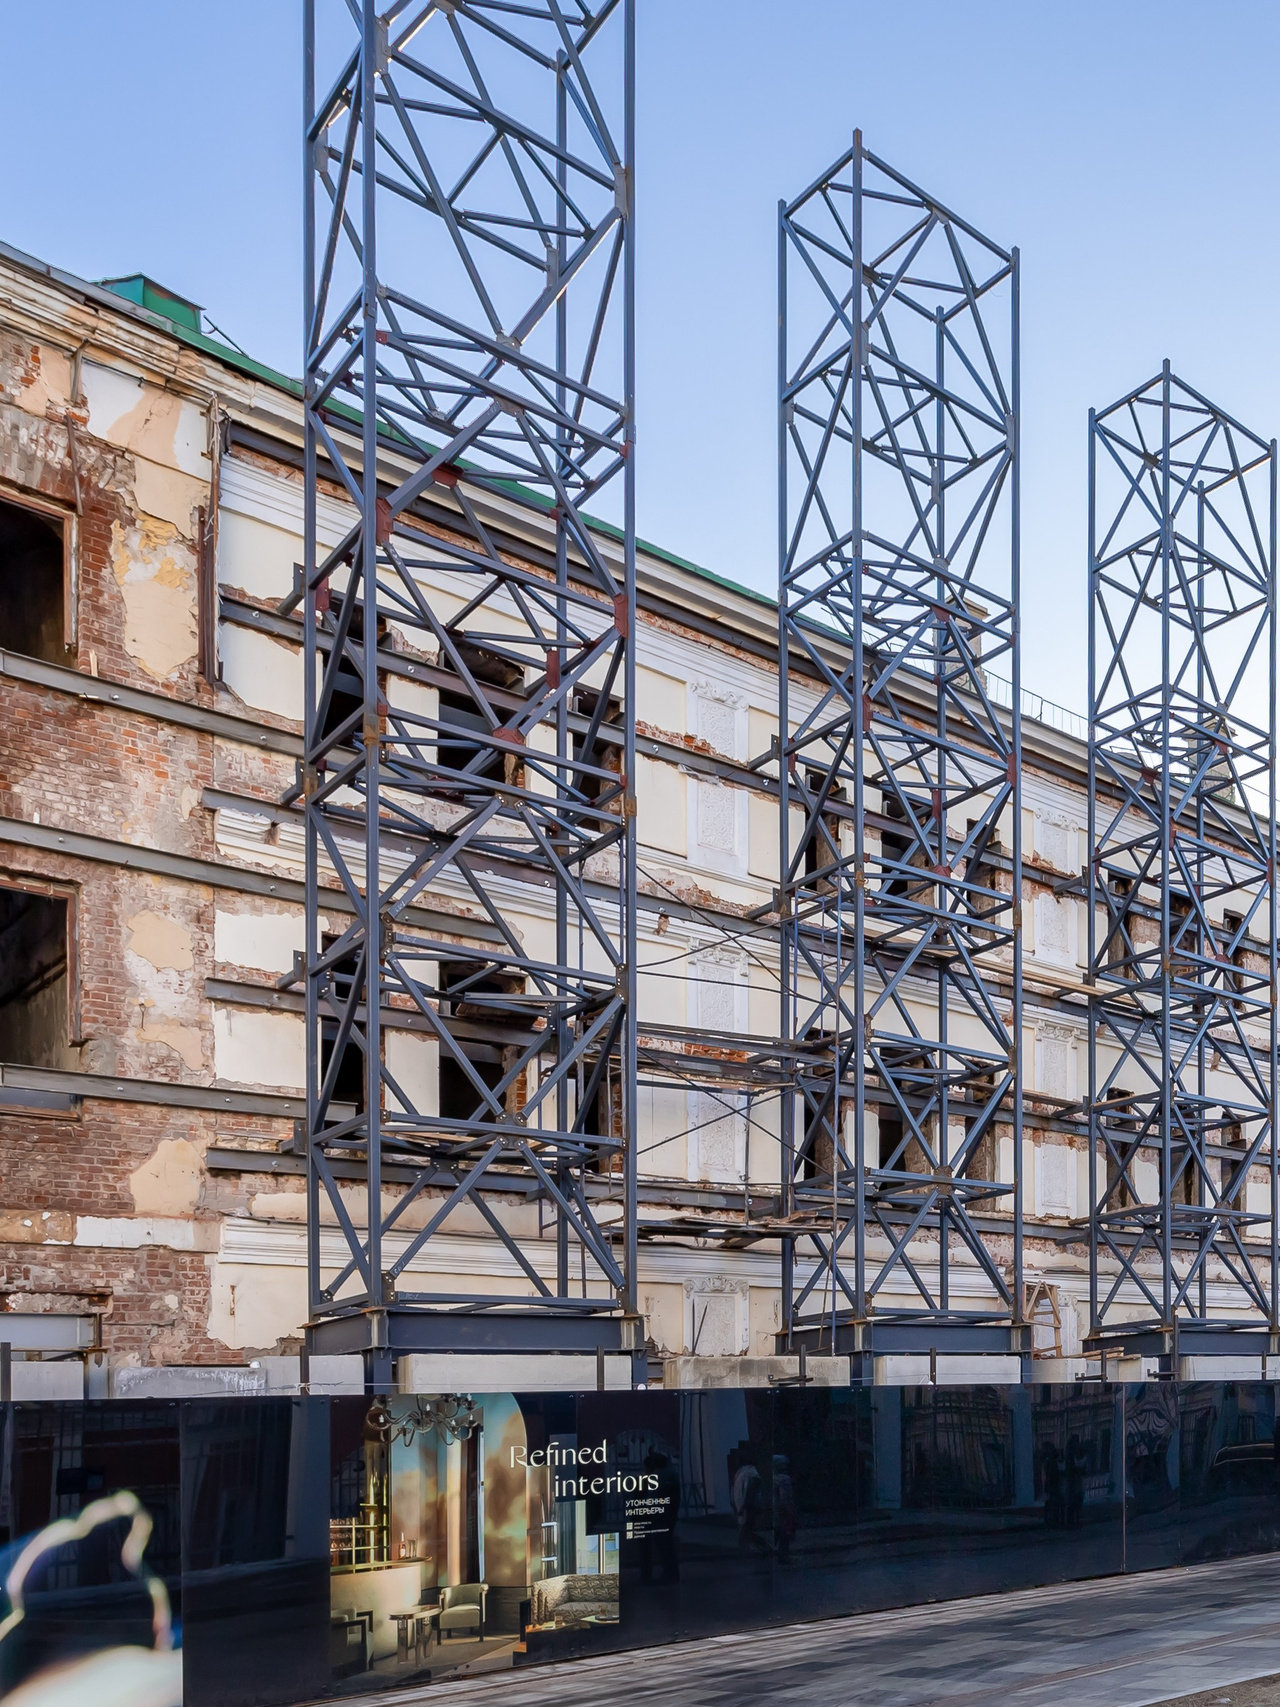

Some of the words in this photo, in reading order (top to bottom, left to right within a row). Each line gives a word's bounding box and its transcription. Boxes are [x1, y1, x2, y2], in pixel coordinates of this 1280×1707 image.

[510, 1438, 608, 1469] Refined
[554, 1471, 660, 1498] interiors
[625, 1496, 671, 1507] УТОНЧЕННЫЕ
[625, 1507, 665, 1516] ИНТЕРЬЕРЫ
